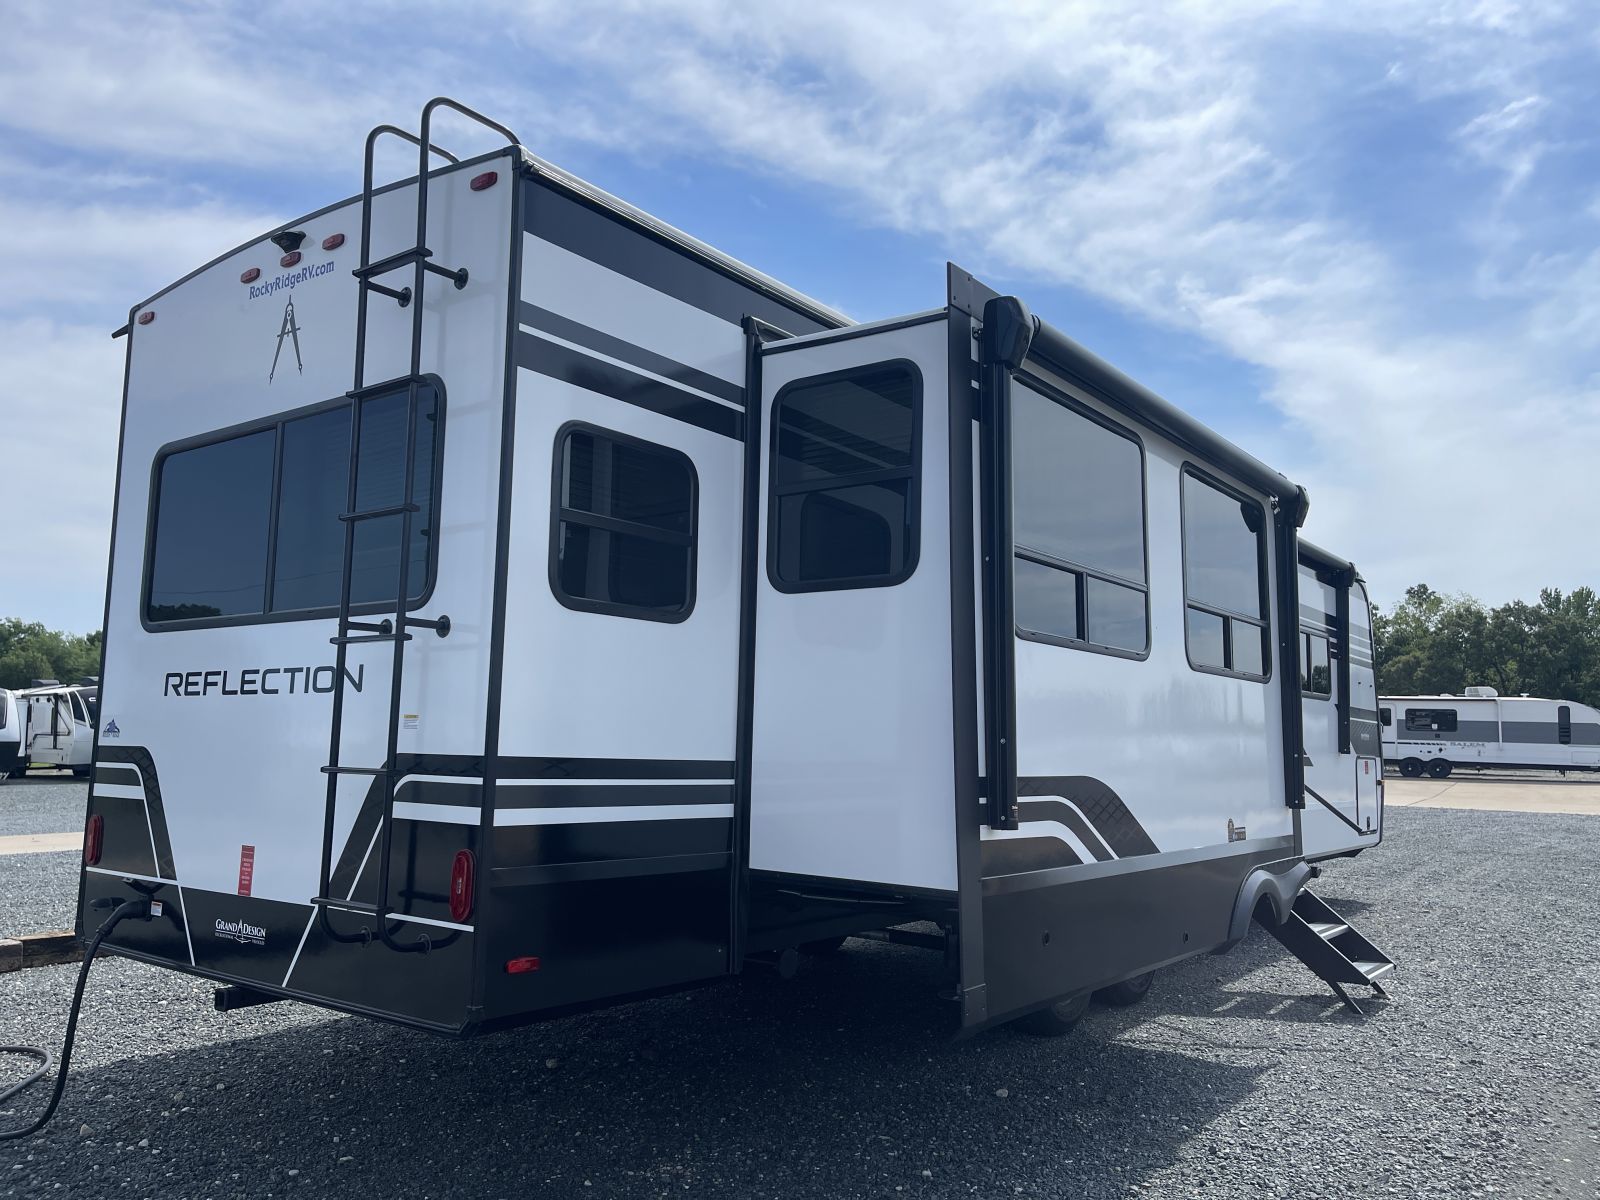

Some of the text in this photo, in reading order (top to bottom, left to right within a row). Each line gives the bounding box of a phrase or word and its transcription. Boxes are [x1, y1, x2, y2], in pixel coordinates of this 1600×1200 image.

[249, 261, 335, 300] RockyRidgeRV.com
[164, 664, 364, 697] REFLECTION
[243, 923, 266, 938] DESIGN
